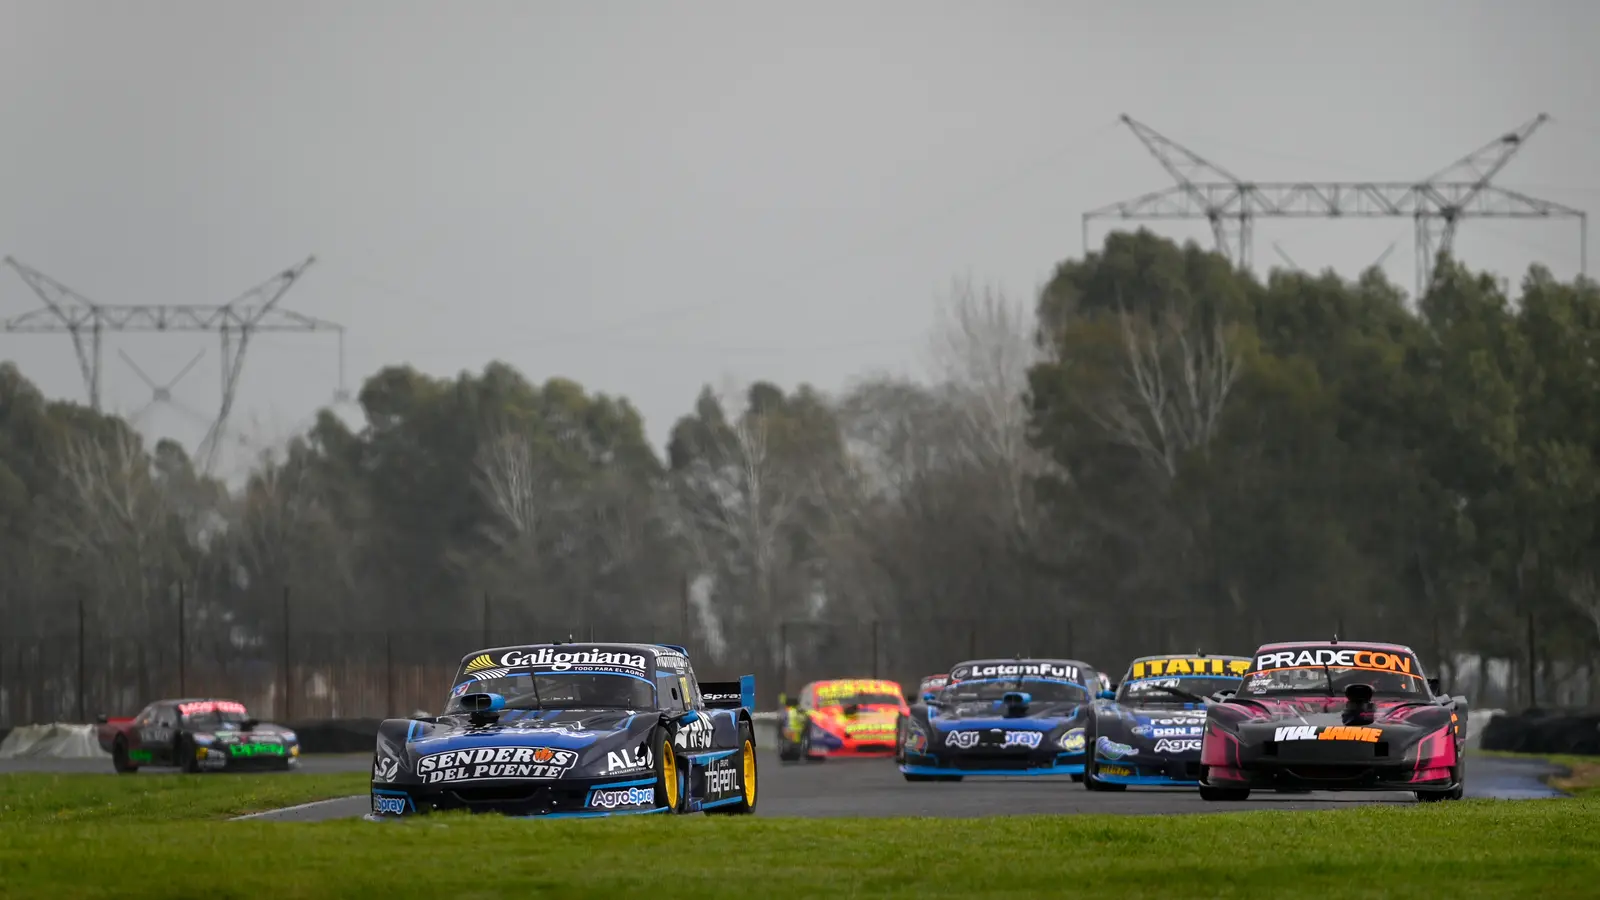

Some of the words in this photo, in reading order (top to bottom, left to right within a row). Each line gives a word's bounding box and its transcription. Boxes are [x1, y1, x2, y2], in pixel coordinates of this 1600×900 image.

[501, 648, 646, 671] Galigniana
[1133, 659, 1223, 678] ITATI
[1257, 650, 1410, 672] PRADECON
[625, 668, 645, 678] AGRO
[972, 663, 1078, 680] LatamFull
[1274, 726, 1318, 742] VIAL
[1318, 726, 1383, 743] JAIME
[421, 748, 573, 773] SENDEROS
[430, 768, 469, 783] DEL
[473, 764, 562, 777] PUENTE
